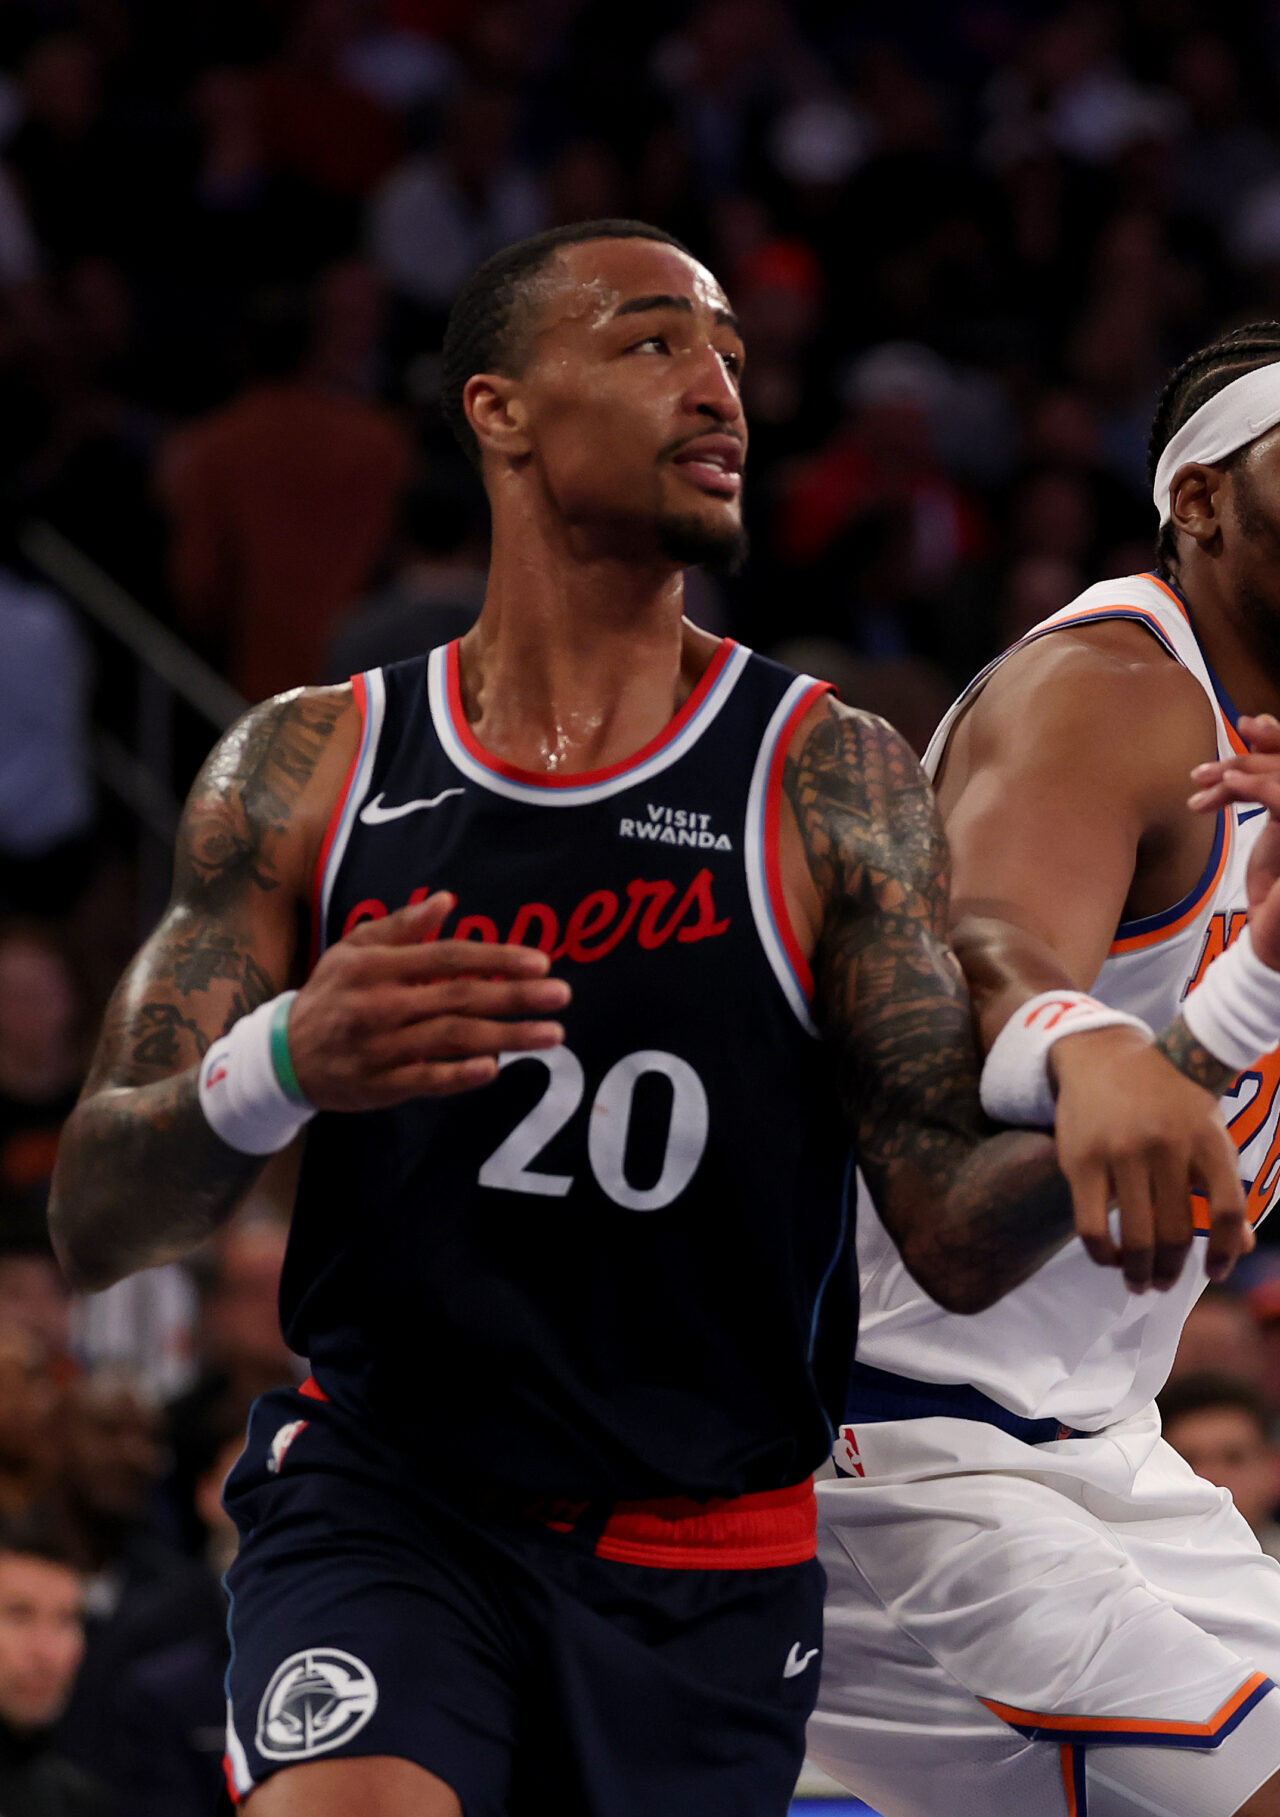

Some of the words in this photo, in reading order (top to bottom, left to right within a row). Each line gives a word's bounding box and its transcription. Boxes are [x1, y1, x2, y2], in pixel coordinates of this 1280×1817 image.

[647, 804, 712, 830] VISIT
[619, 818, 733, 851] RWANDA
[478, 1045, 709, 1213] 20
